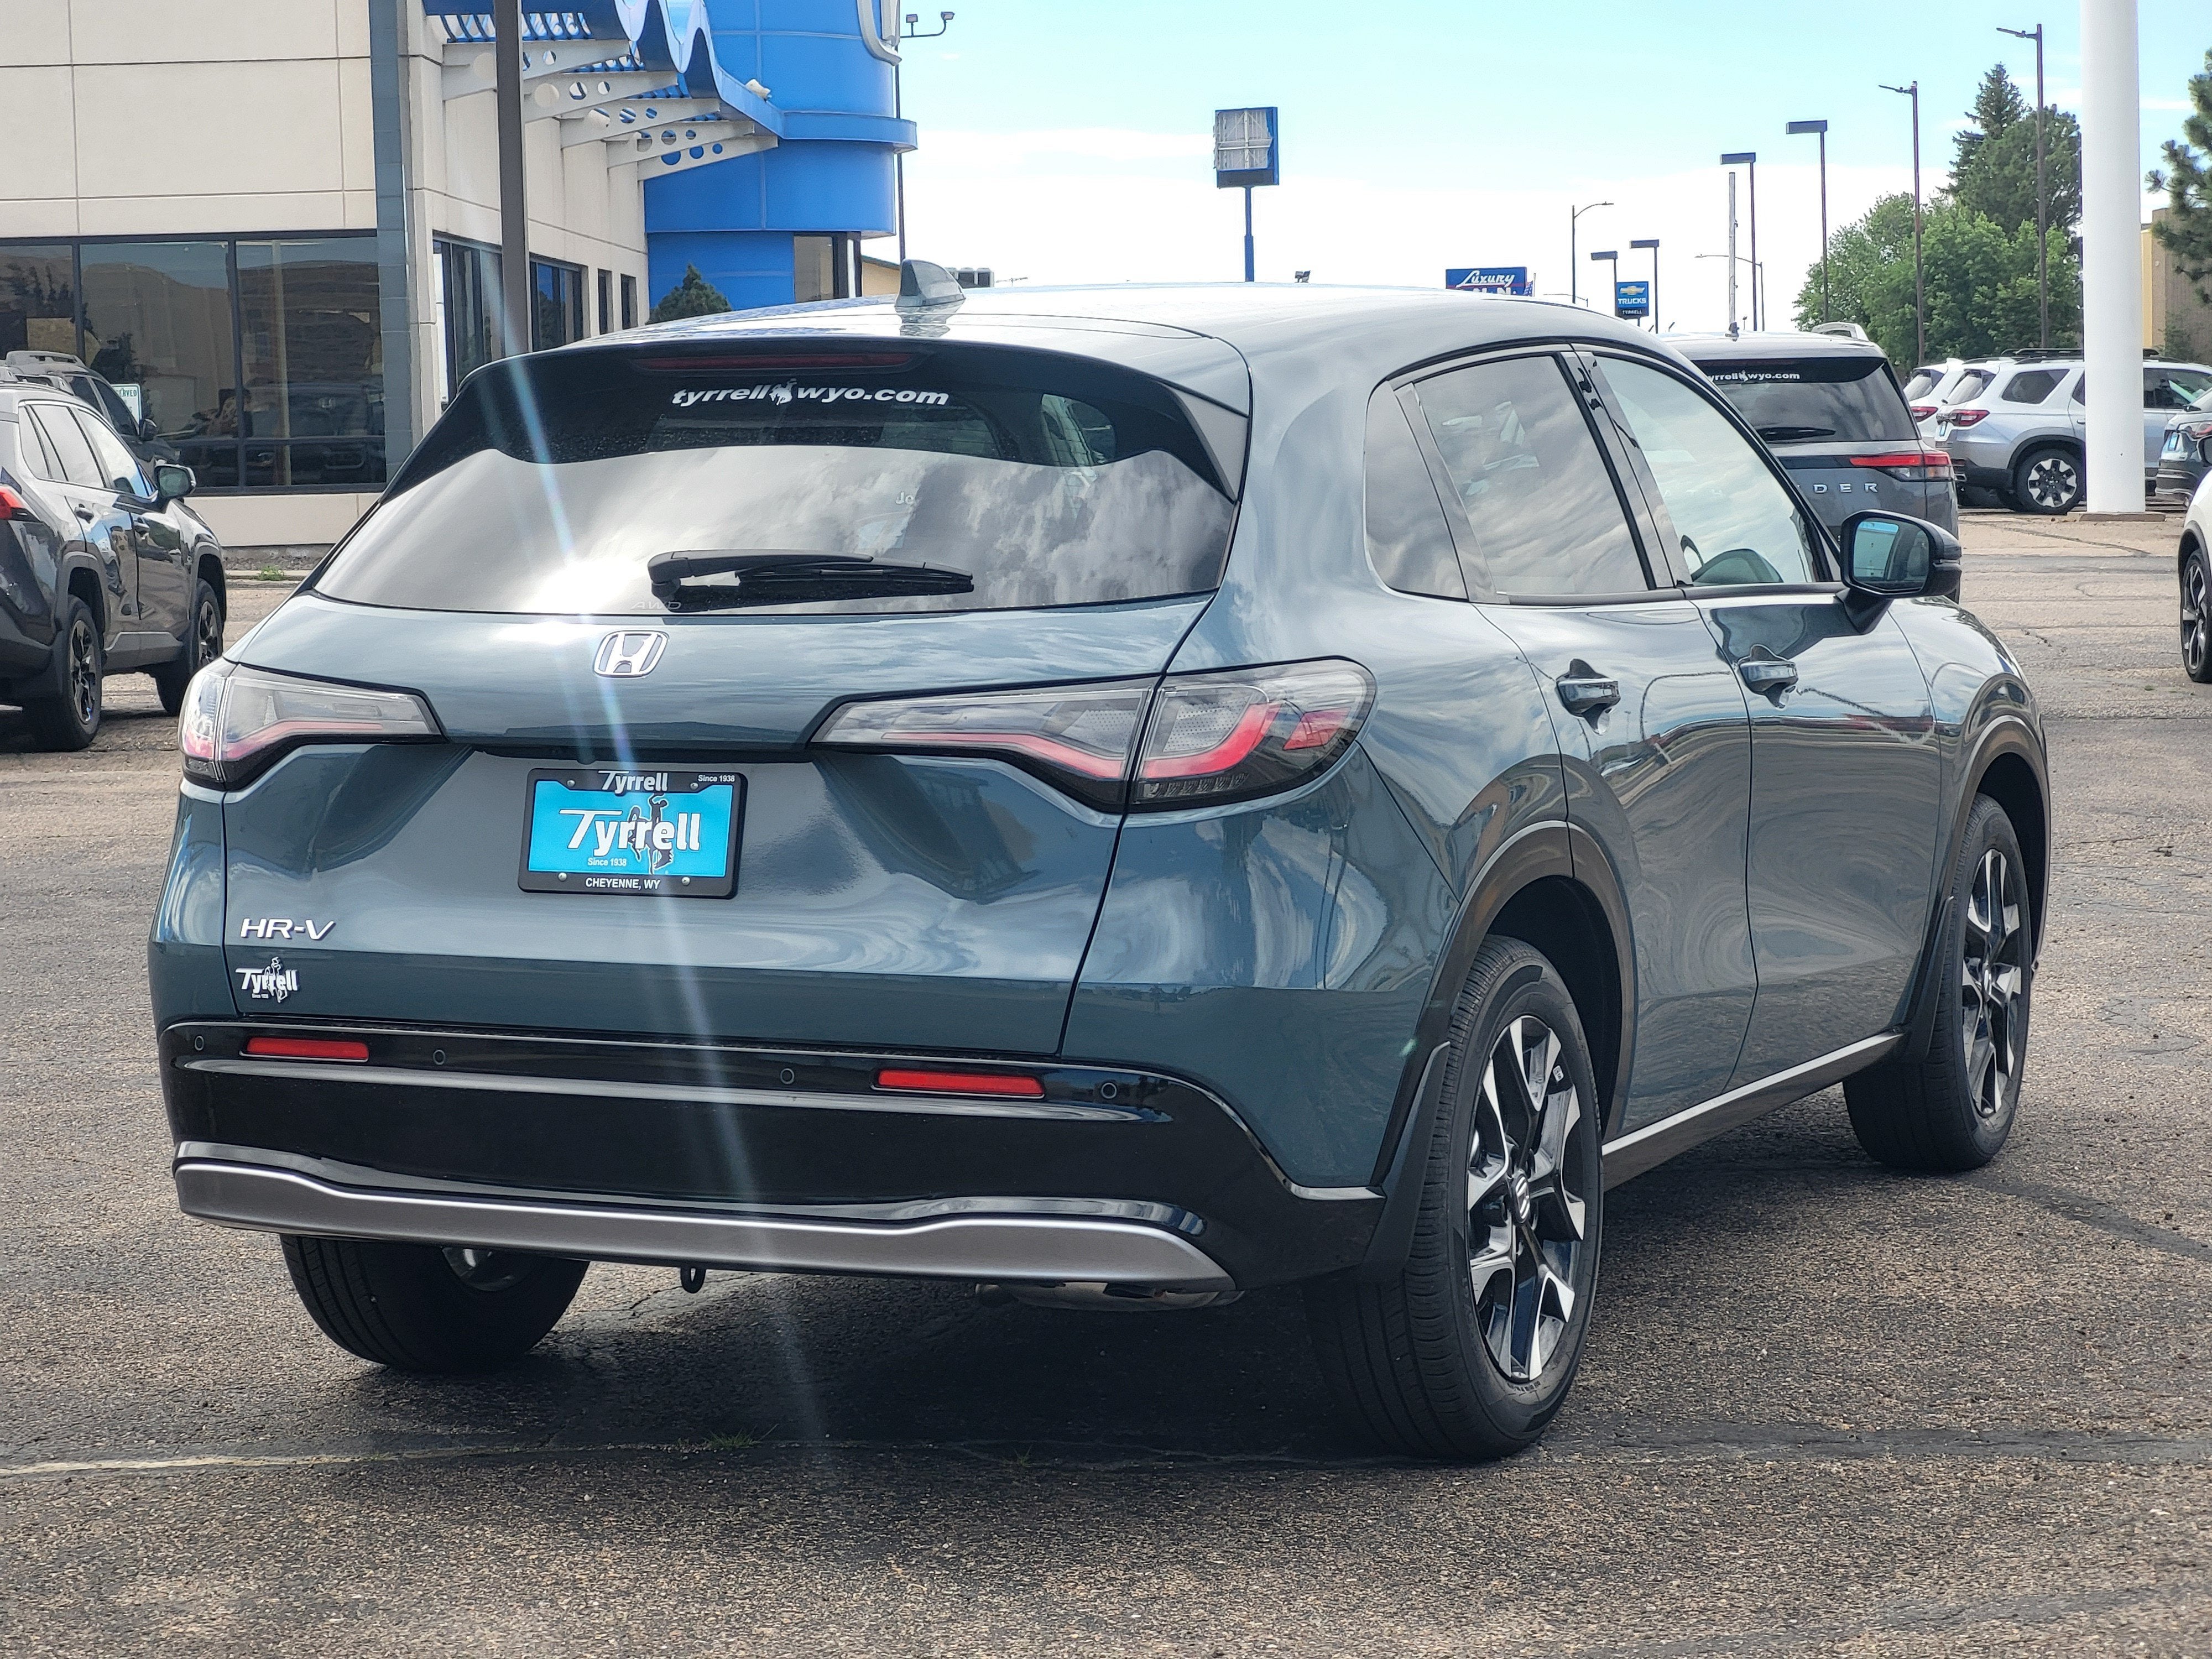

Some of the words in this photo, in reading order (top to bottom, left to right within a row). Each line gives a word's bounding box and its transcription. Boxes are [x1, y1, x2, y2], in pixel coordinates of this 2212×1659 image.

[1456, 270, 1515, 288] Luxury
[1797, 483, 1878, 493] DER
[598, 770, 668, 794] Tyrrell
[559, 809, 701, 857] Tyrrell
[587, 858, 608, 866] Since
[610, 858, 627, 867] 1938
[586, 878, 641, 890] CHEYENNE,
[644, 879, 661, 889] WY
[240, 918, 335, 940] HR-V
[235, 968, 299, 994] Tyrrell
